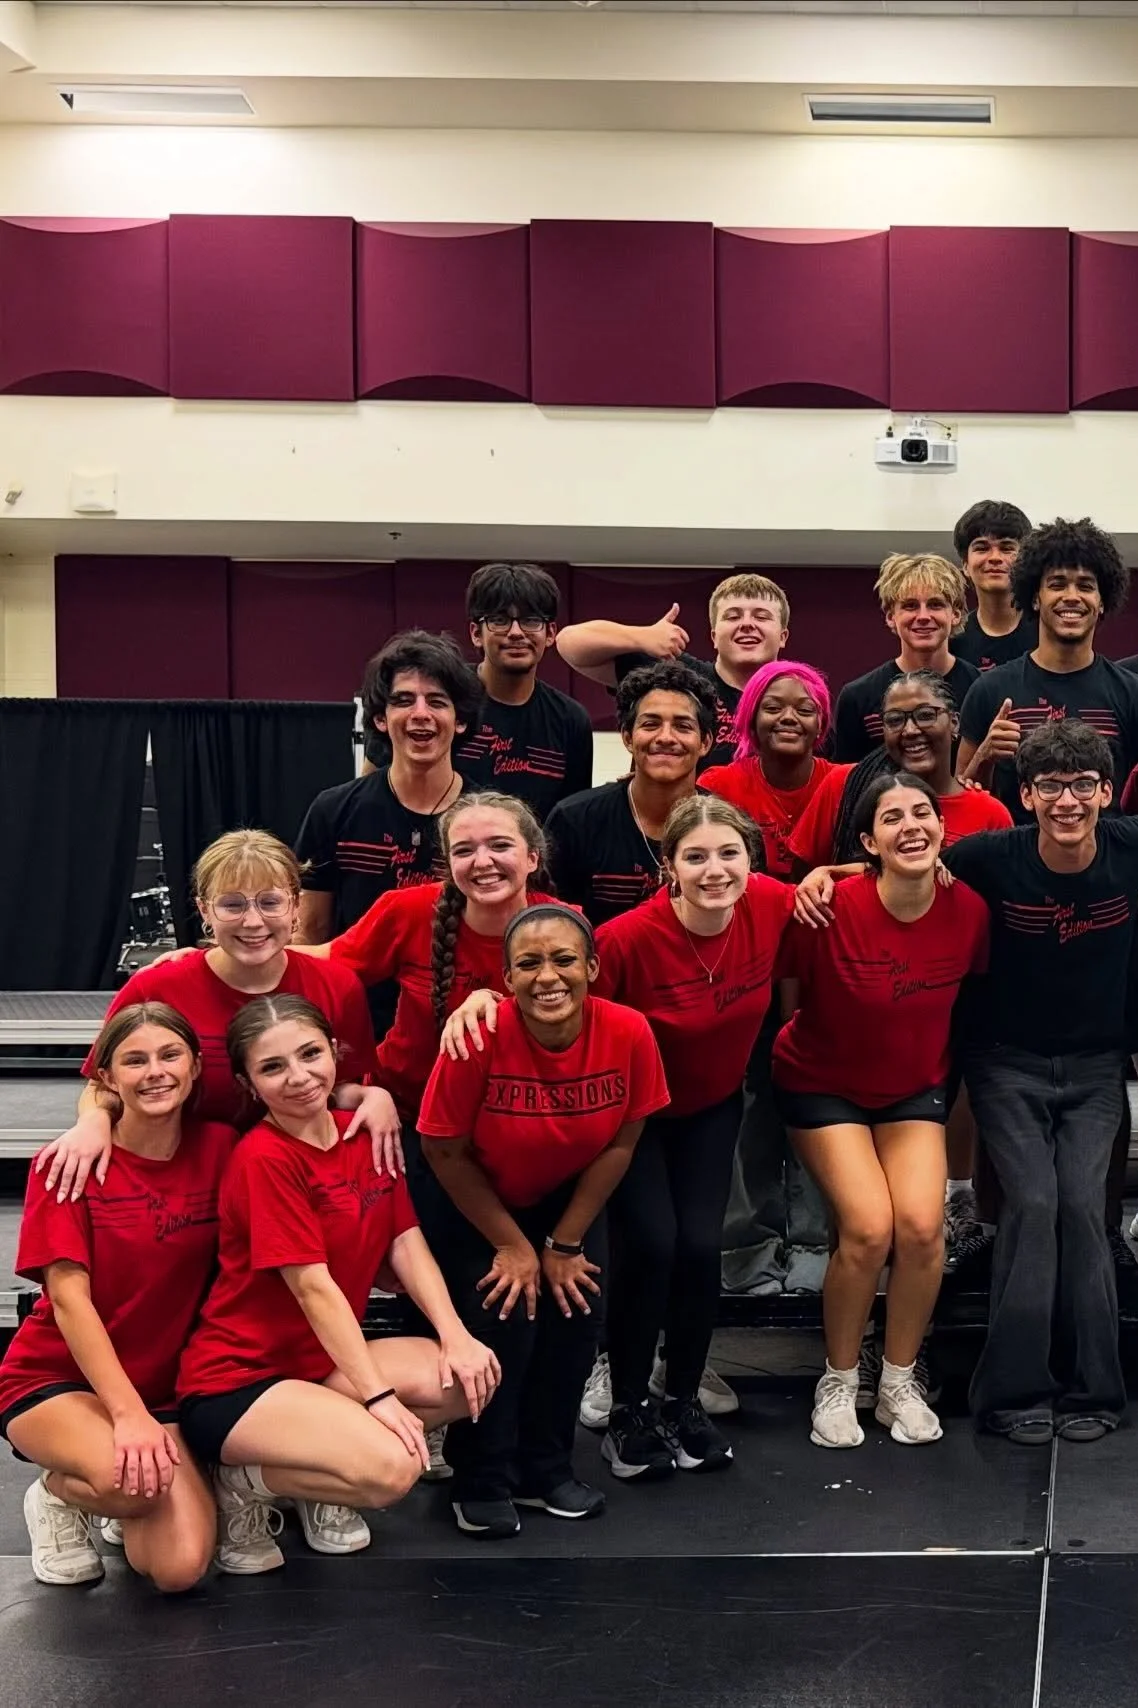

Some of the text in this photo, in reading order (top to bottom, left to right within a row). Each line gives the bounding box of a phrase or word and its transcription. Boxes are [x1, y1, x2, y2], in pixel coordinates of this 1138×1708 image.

[489, 735, 514, 756] First
[494, 755, 530, 776] Edition
[390, 845, 417, 869] First
[1053, 902, 1076, 927] First
[1059, 919, 1094, 944] Edition
[892, 979, 931, 1002] Edition
